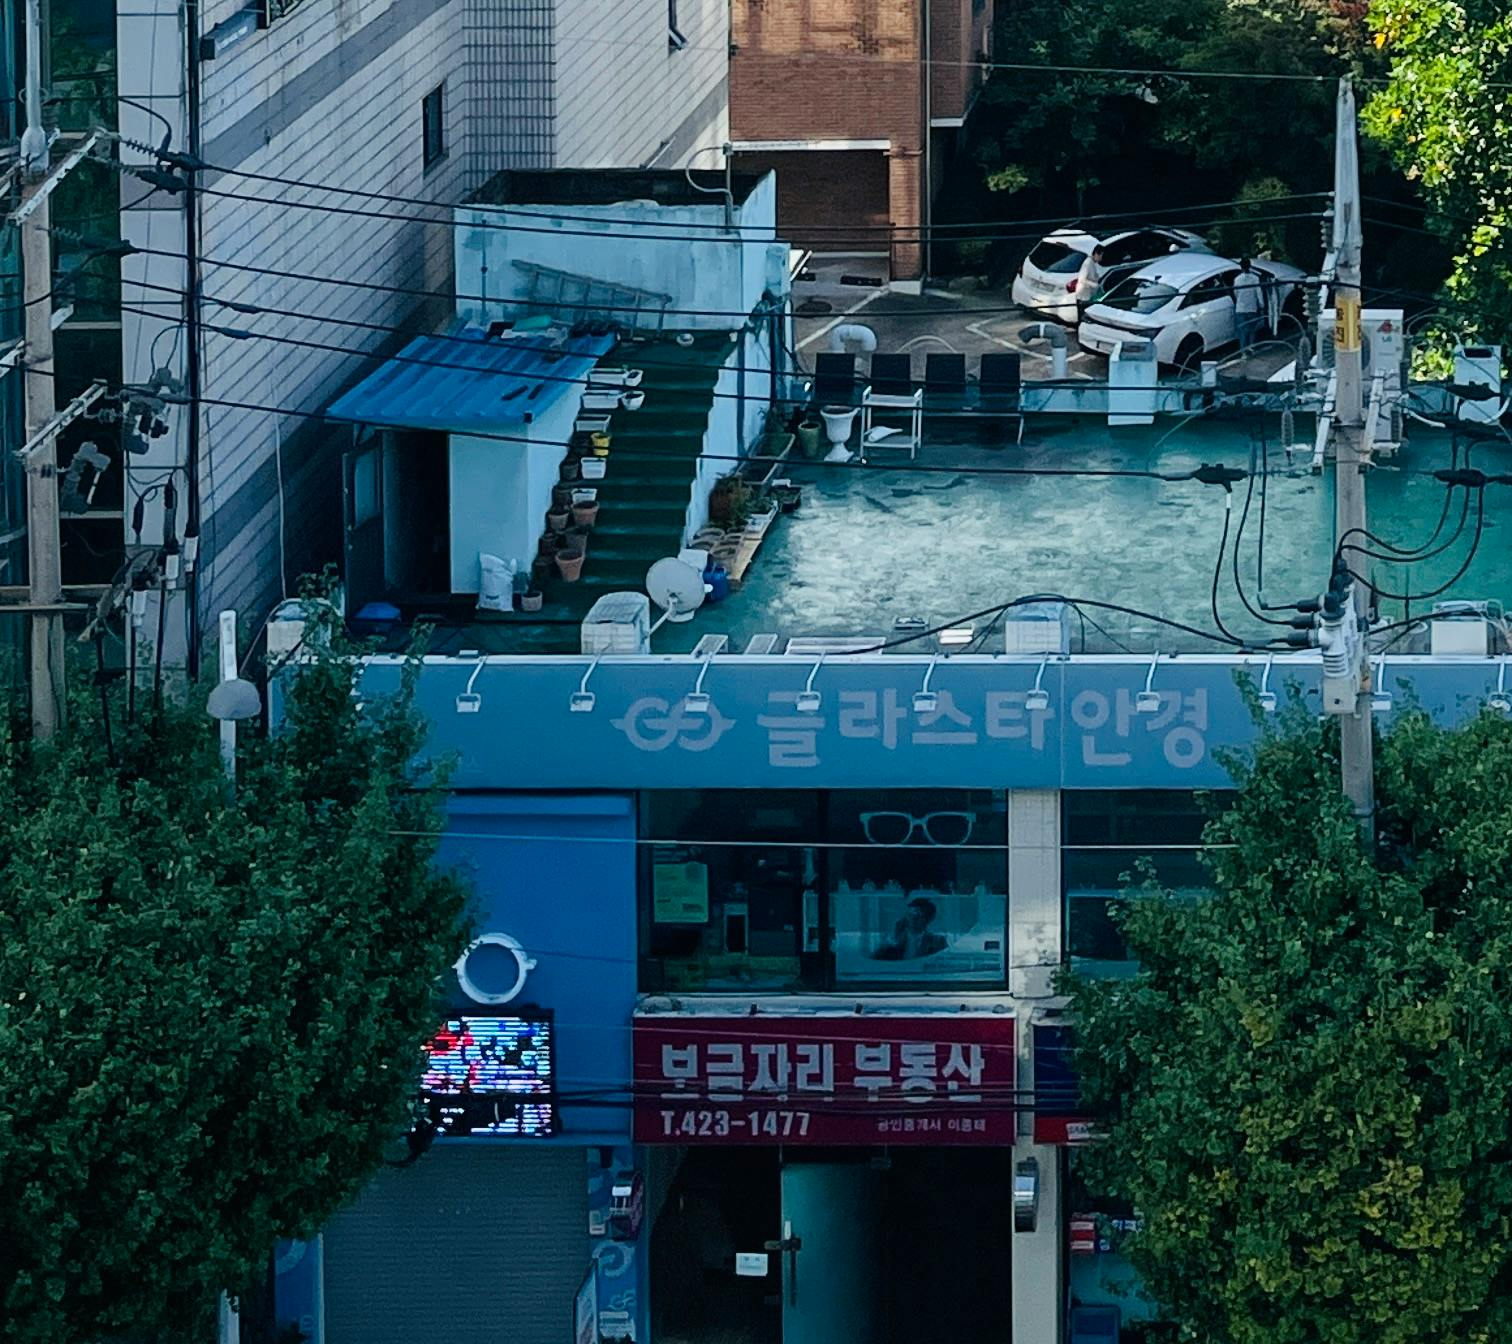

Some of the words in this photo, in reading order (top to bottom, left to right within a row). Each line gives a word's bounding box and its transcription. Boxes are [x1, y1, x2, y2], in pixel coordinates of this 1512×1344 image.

[757, 687, 1209, 768] 글라스타안경
[660, 1043, 835, 1103] 보금자리
[854, 1042, 986, 1104] 부동산
[661, 1110, 812, 1136] T.423-1477
